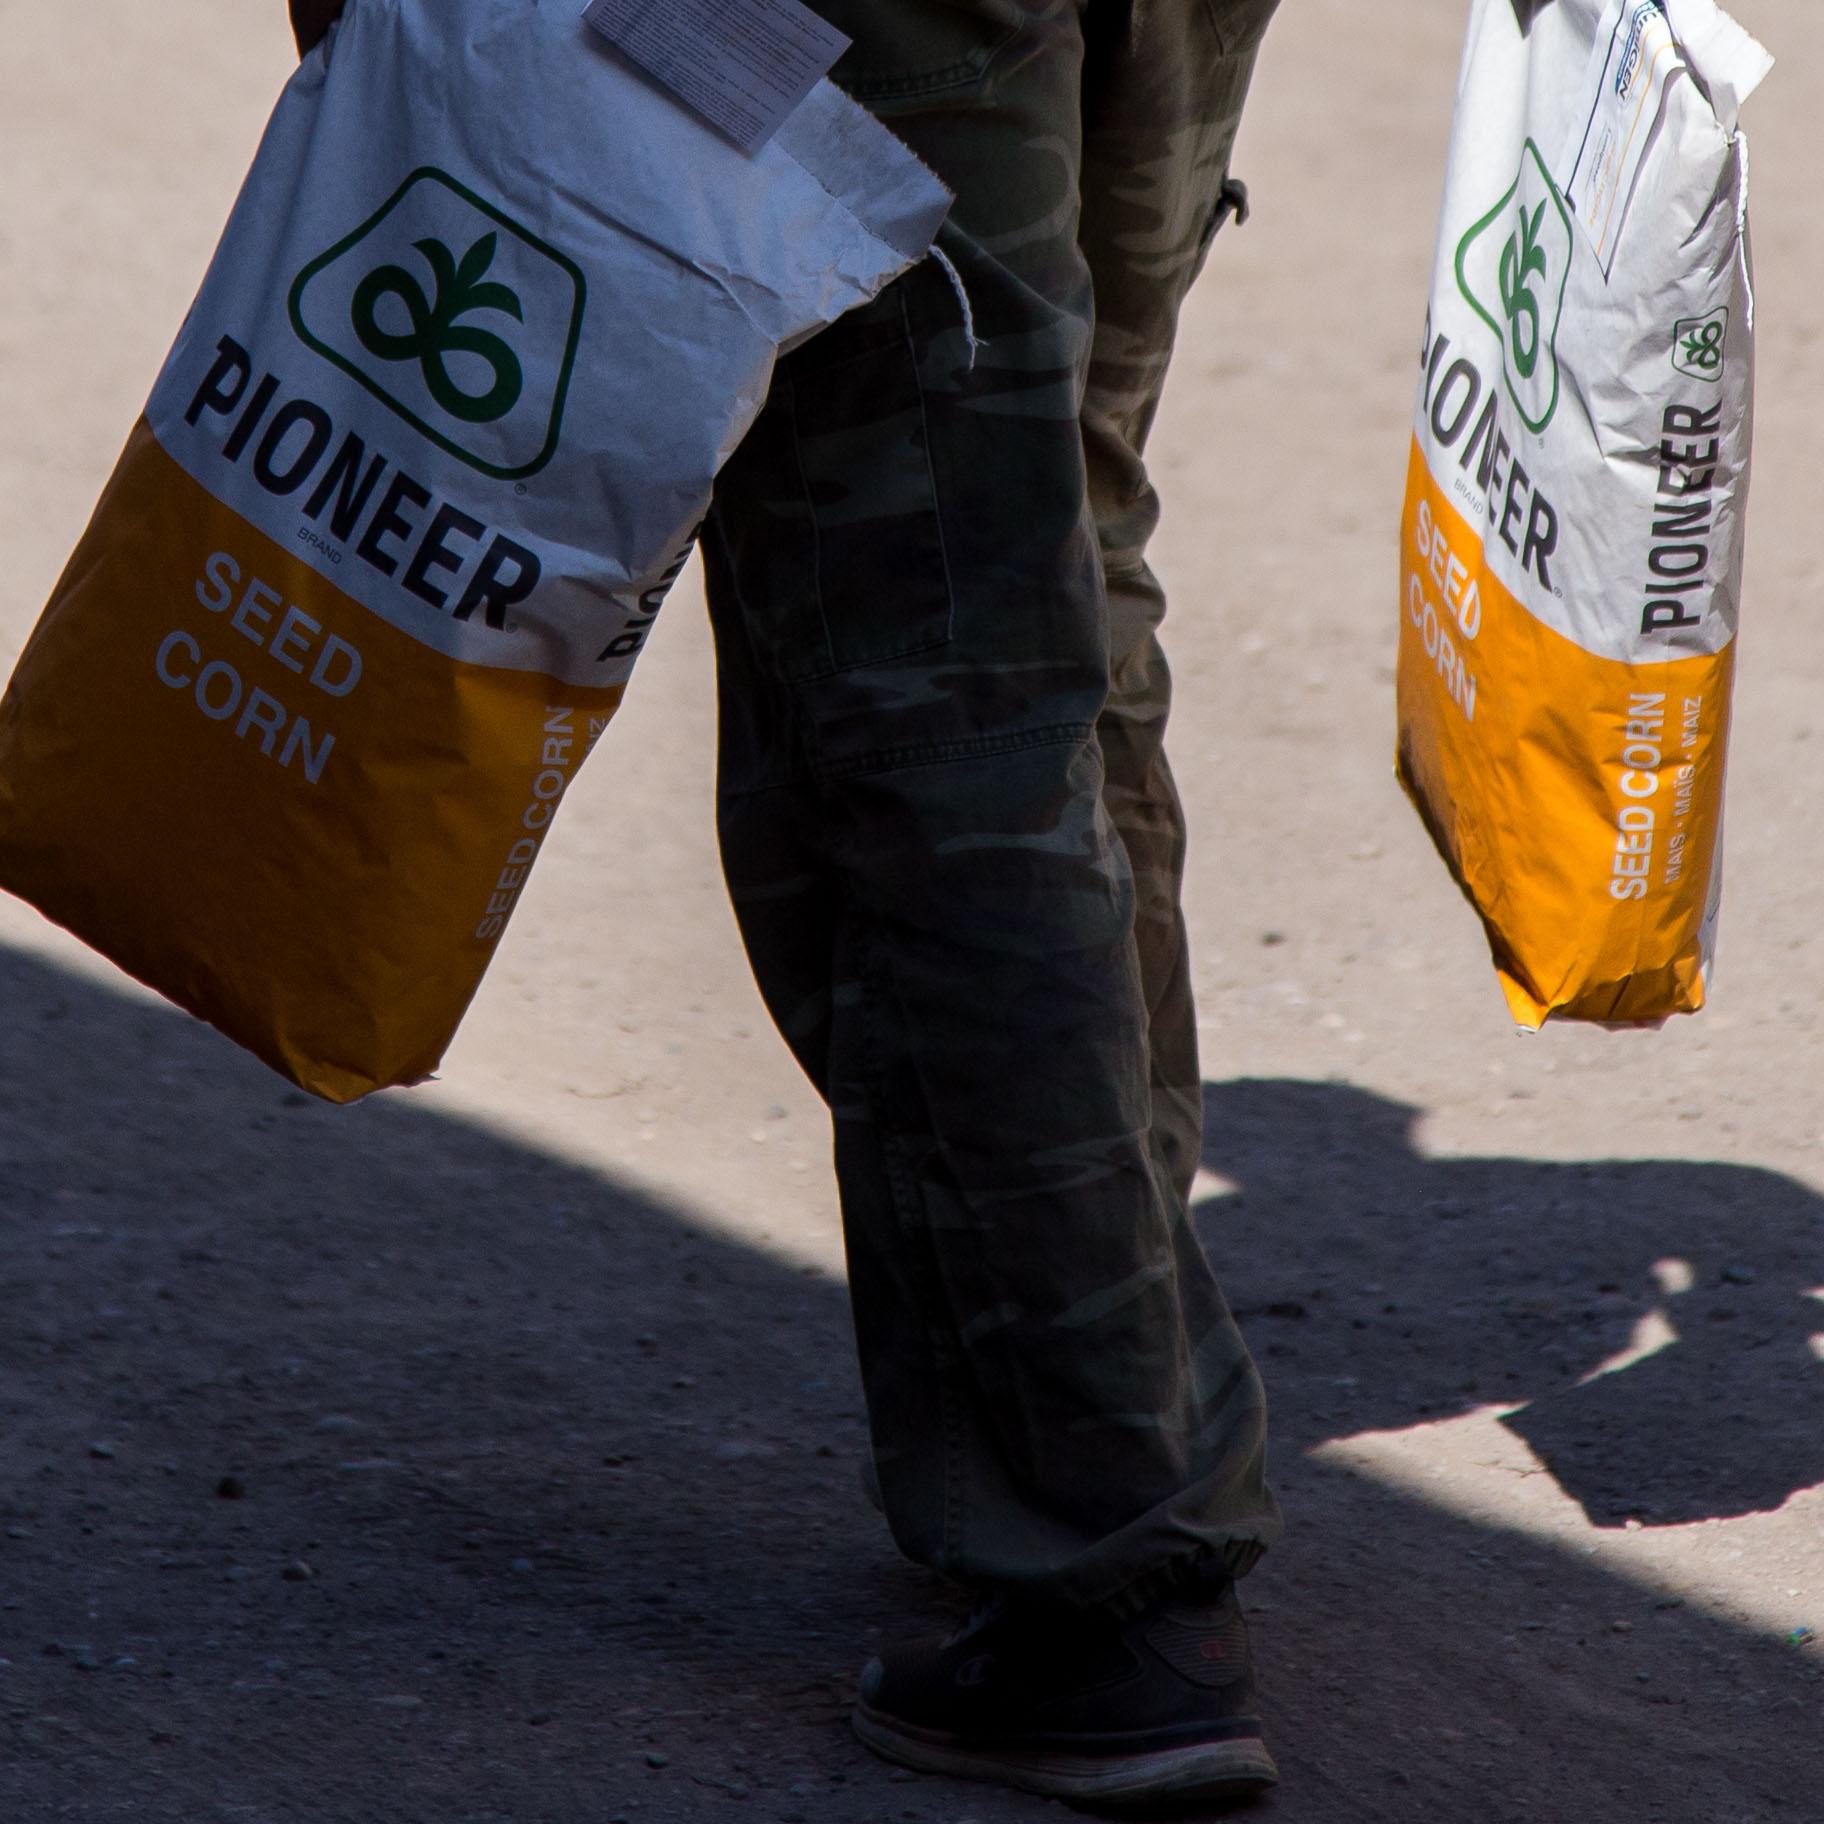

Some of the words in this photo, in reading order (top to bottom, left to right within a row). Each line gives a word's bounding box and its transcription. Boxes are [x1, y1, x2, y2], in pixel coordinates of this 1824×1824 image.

[183, 334, 543, 632] PIONEER
[296, 526, 343, 566] BRAND
[1454, 478, 1483, 515] BRAND
[1640, 397, 1722, 634] PIONEER
[195, 551, 363, 697] SEED
[1415, 499, 1482, 641] SEED
[155, 629, 336, 785] CORN
[1408, 572, 1476, 722] CORN
[1620, 692, 1666, 798] CORN
[475, 836, 538, 940] SEED
[522, 705, 574, 831] CORN
[1609, 806, 1655, 900] SEED
